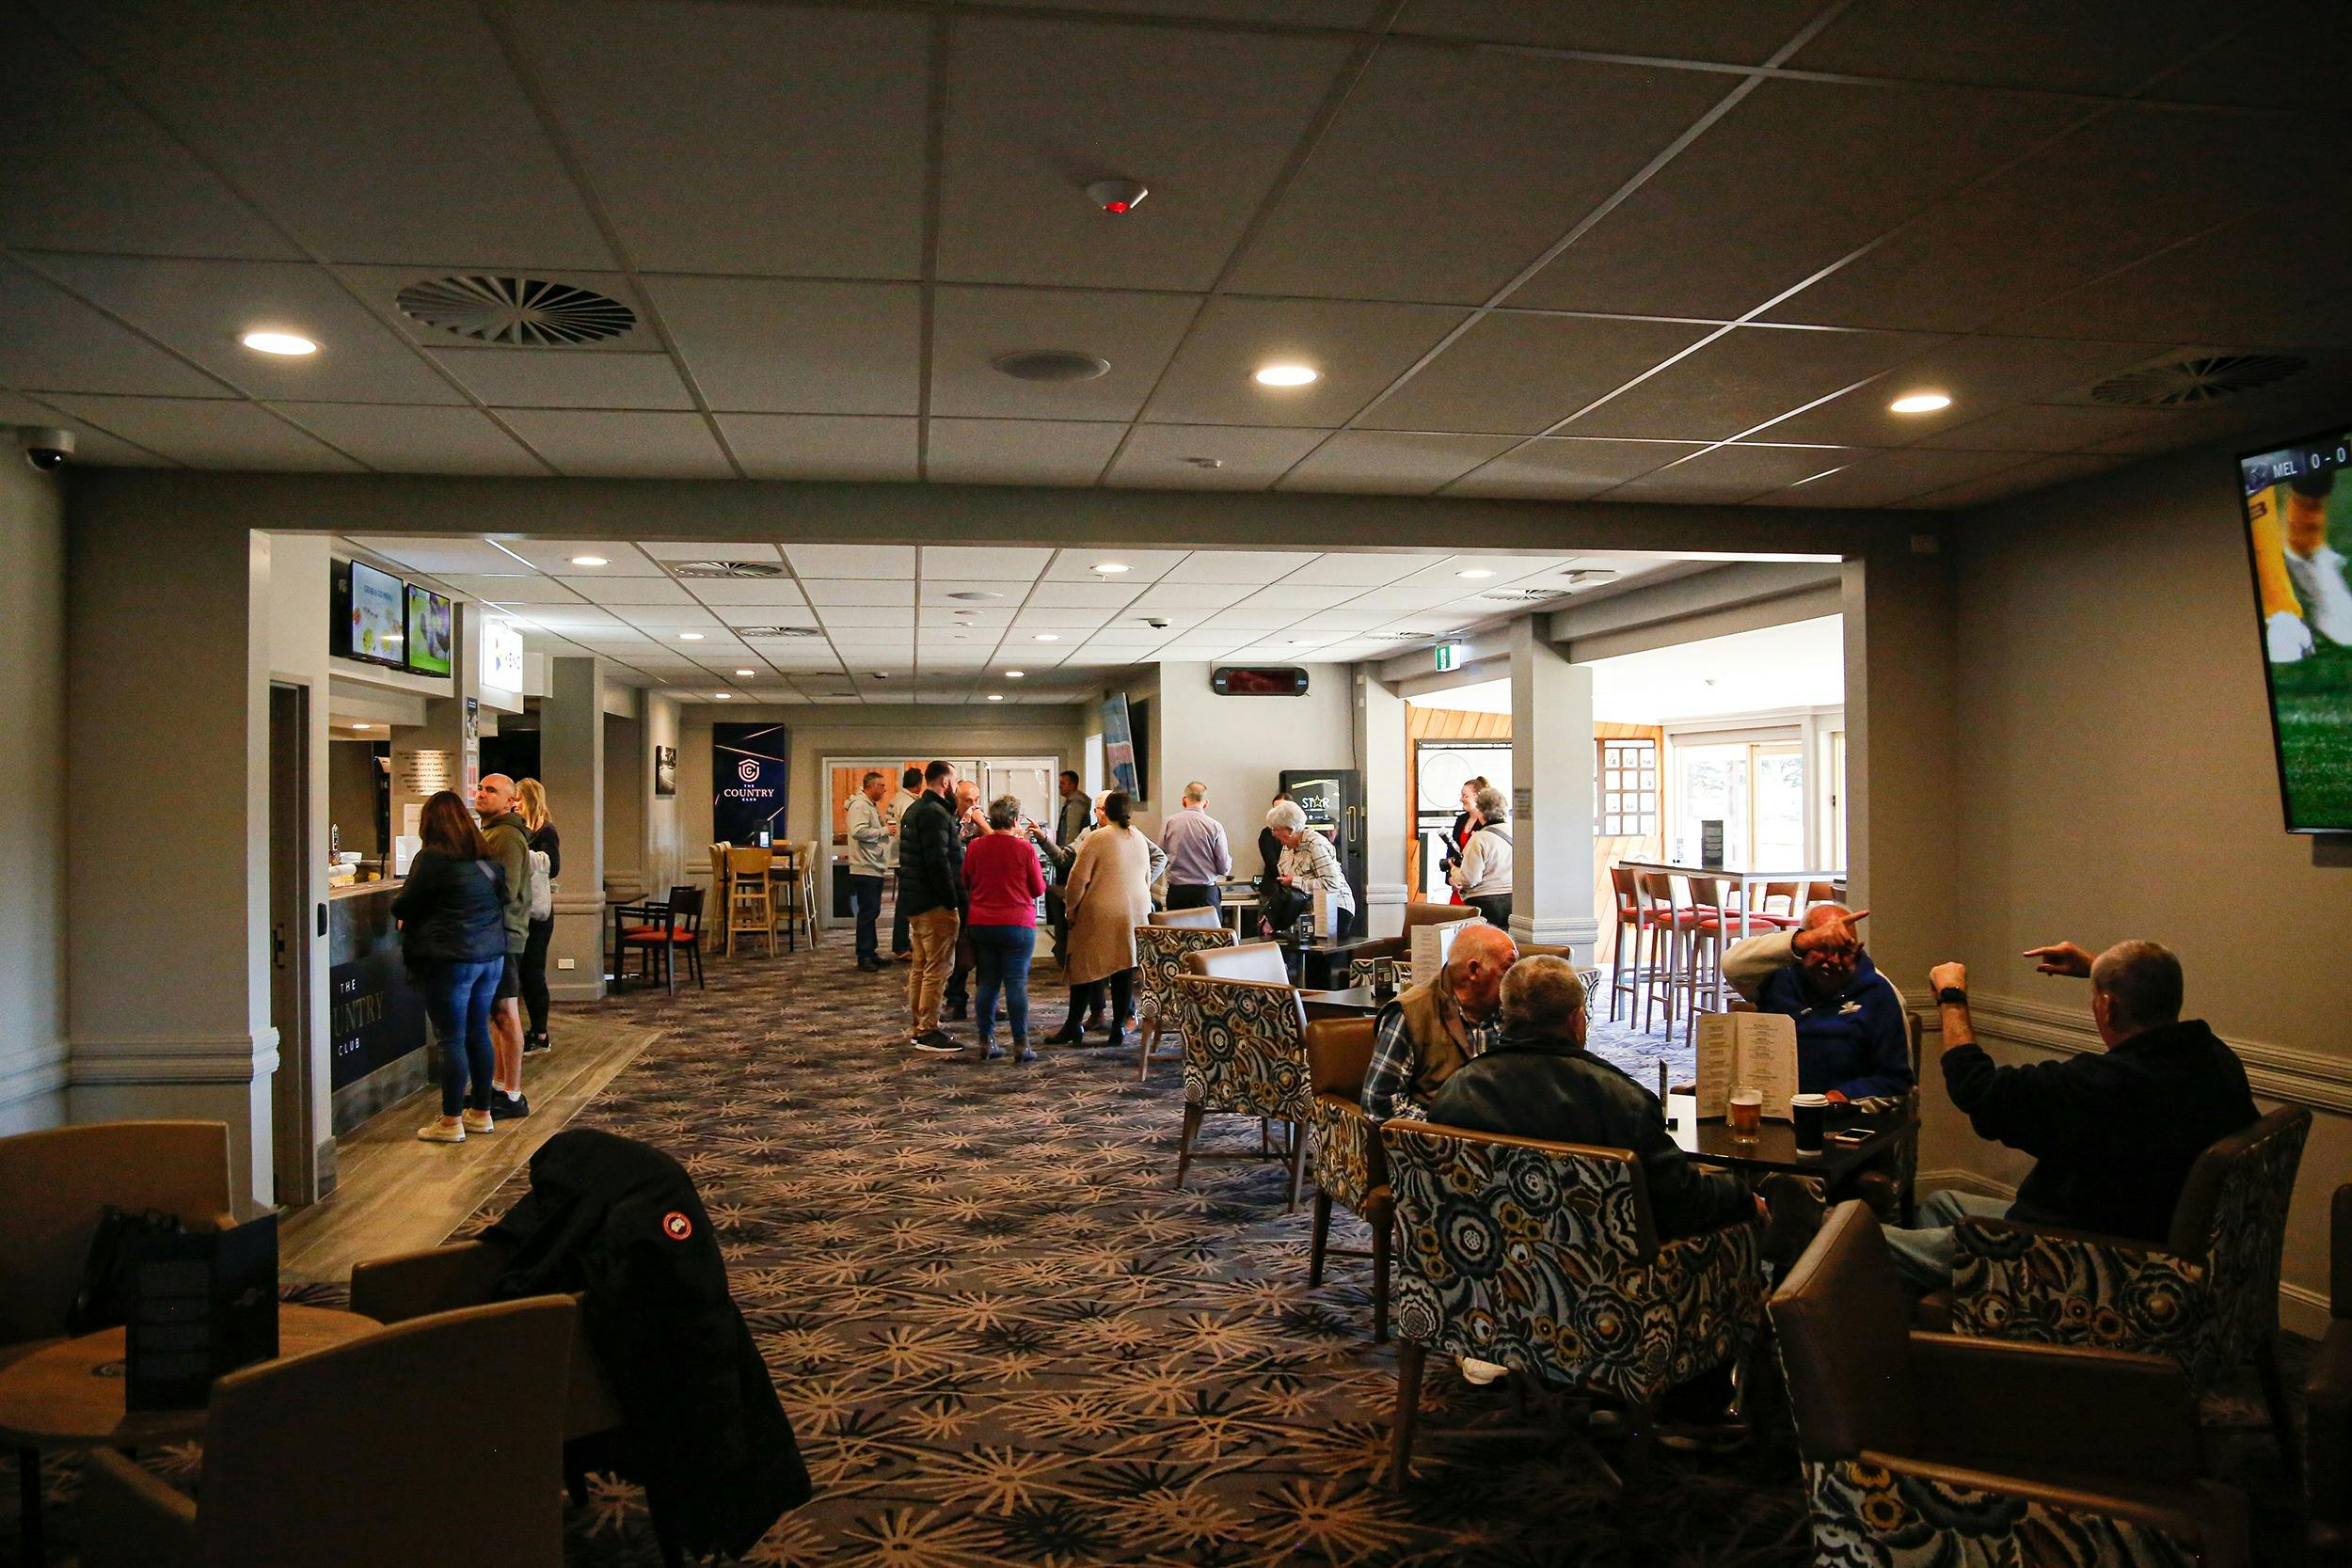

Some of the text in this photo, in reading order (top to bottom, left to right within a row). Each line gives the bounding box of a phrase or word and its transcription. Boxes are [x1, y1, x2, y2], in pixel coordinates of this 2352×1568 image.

[2272, 461, 2298, 479] MEL
[2311, 453, 2321, 469] 0
[2336, 446, 2347, 464] 0
[723, 788, 774, 798] COUNTRY
[340, 978, 356, 994] THE
[332, 990, 384, 1037] UNTRY
[339, 1037, 360, 1056] CLUB
